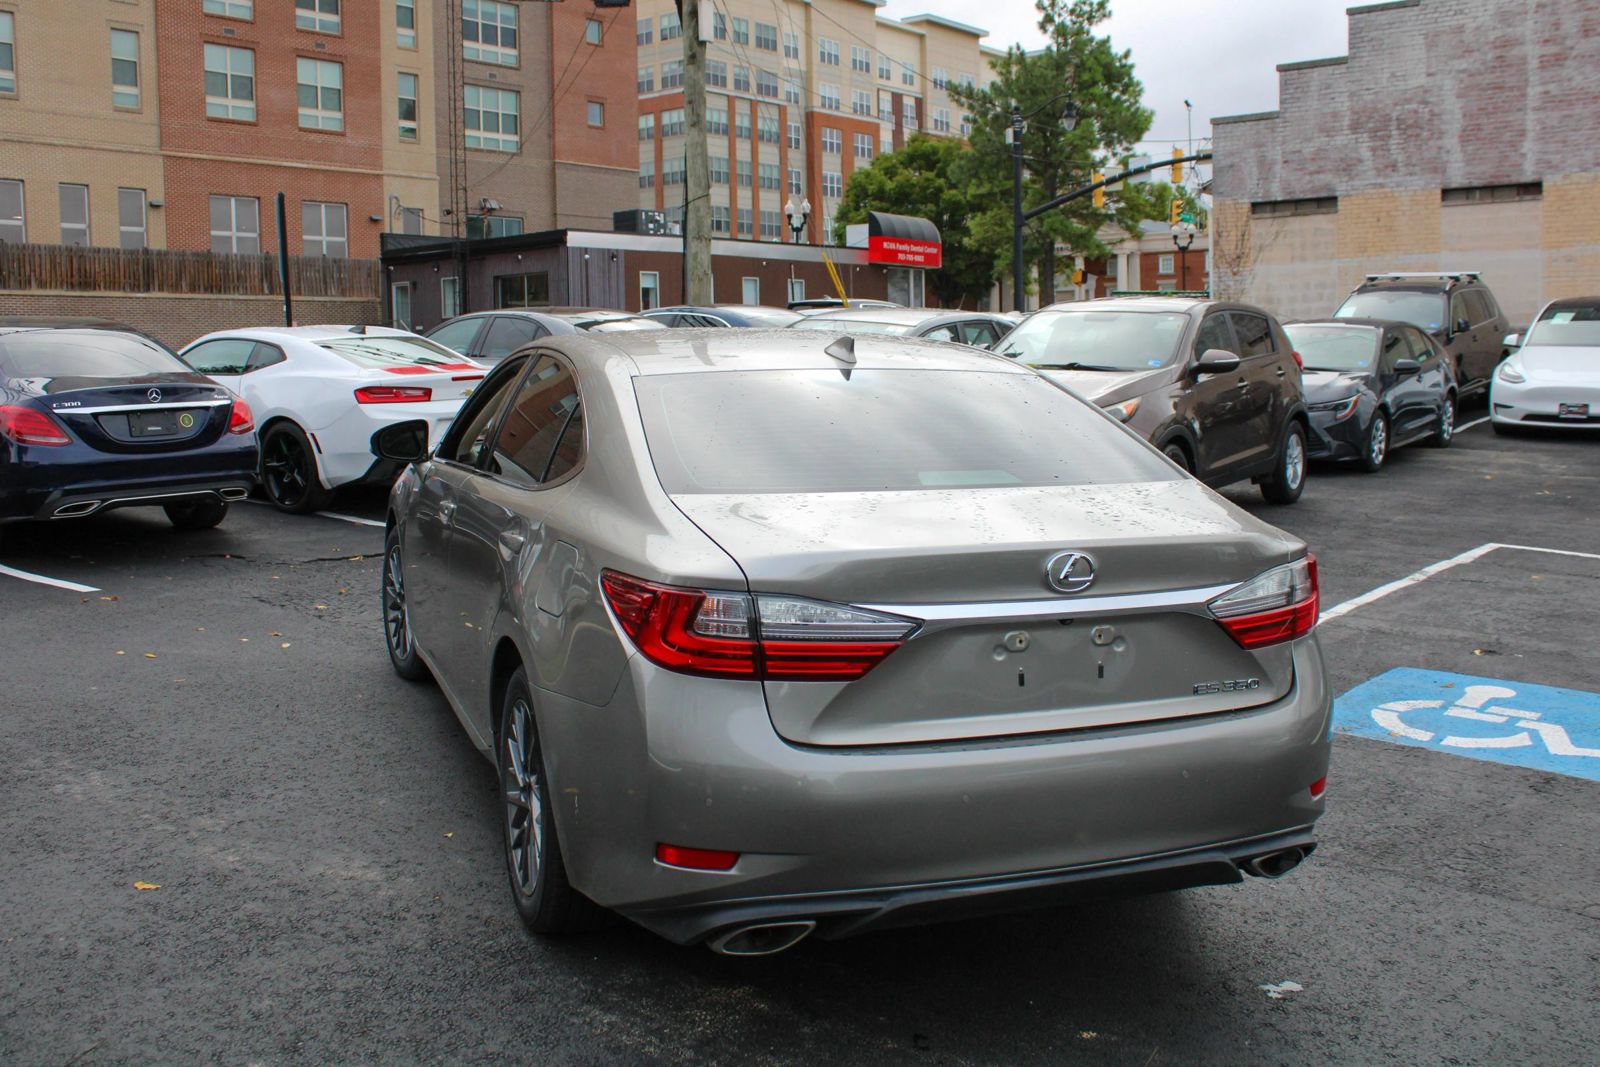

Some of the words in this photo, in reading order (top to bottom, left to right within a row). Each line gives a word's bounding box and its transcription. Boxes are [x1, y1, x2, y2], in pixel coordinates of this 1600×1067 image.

[896, 242, 910, 253] Family
[910, 244, 924, 253] Dental
[924, 245, 938, 254] Center
